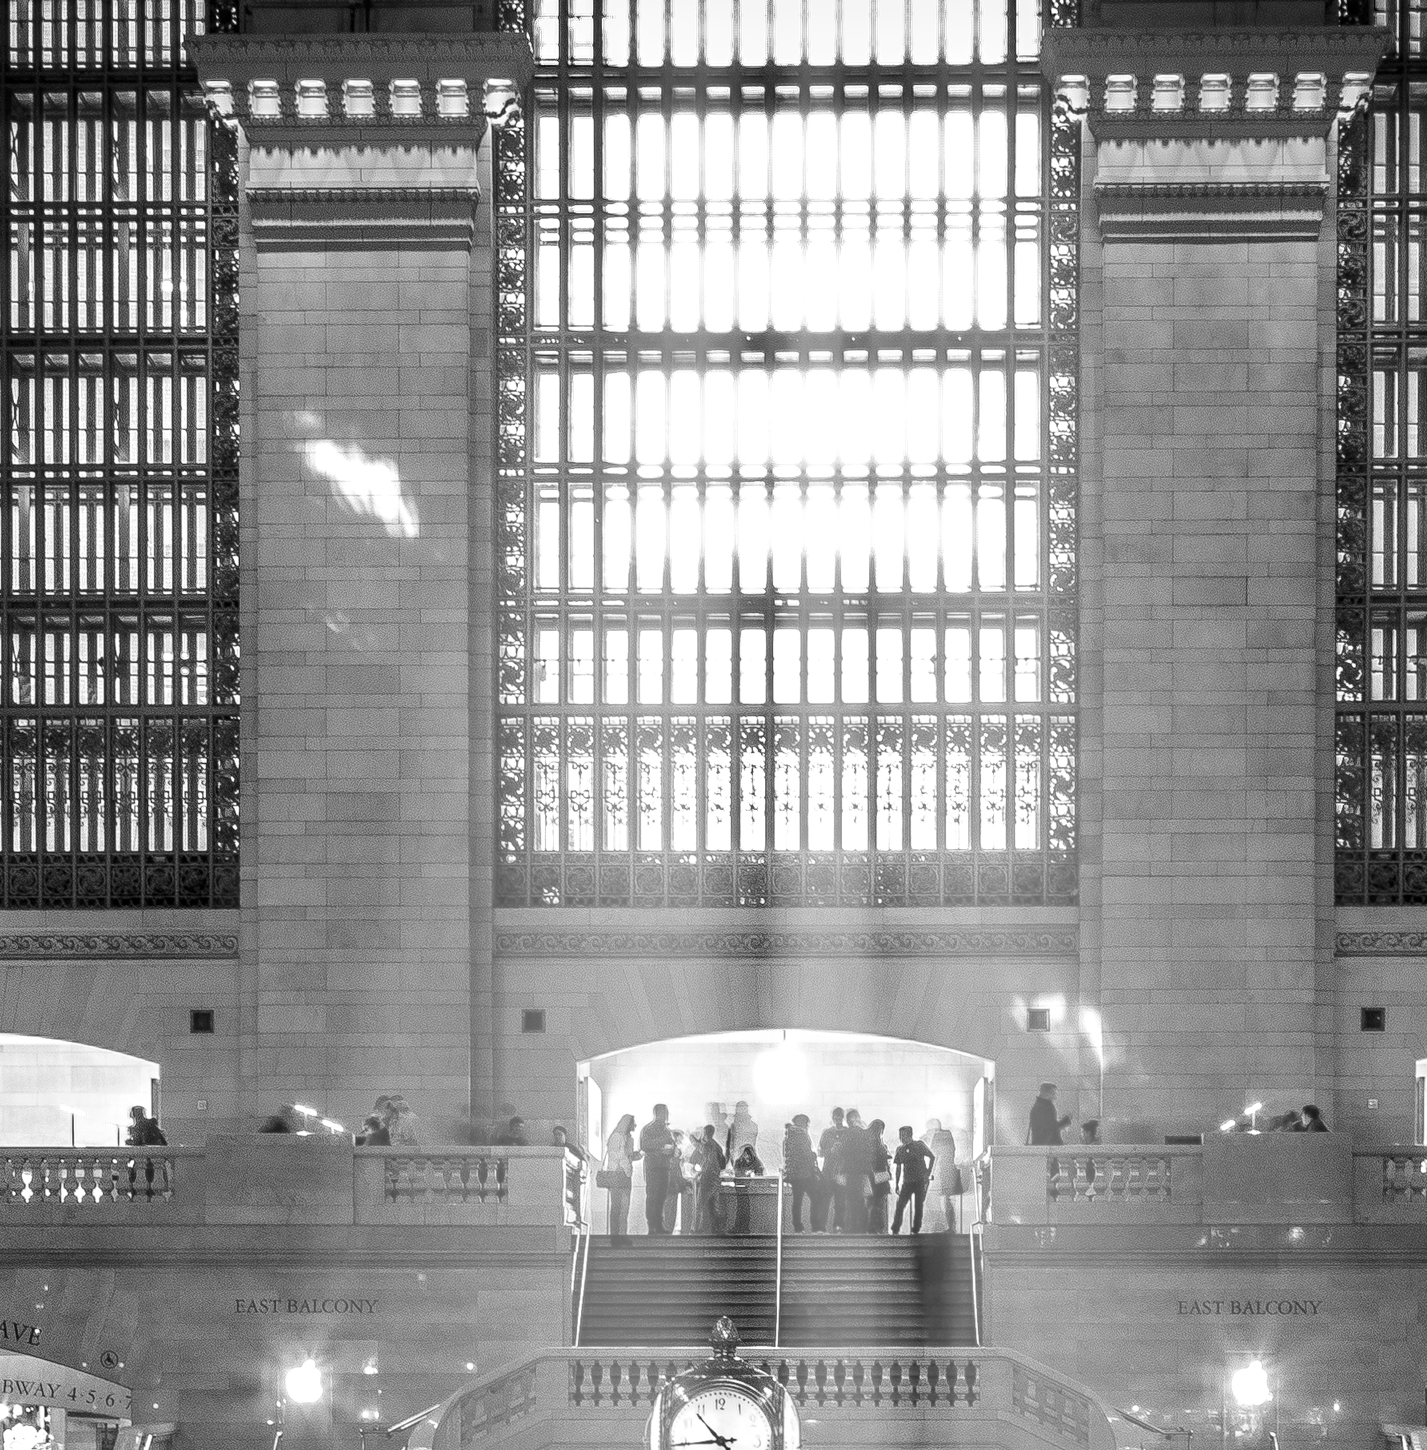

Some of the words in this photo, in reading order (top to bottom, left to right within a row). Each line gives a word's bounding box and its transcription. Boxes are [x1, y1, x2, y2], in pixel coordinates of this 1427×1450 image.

[234, 1298, 281, 1314] EAST
[286, 1298, 379, 1314] BALCONY
[1177, 1299, 1224, 1315] EAST
[1229, 1299, 1322, 1315] BALCONY
[714, 1397, 726, 1411] 12
[738, 1403, 742, 1415] 1
